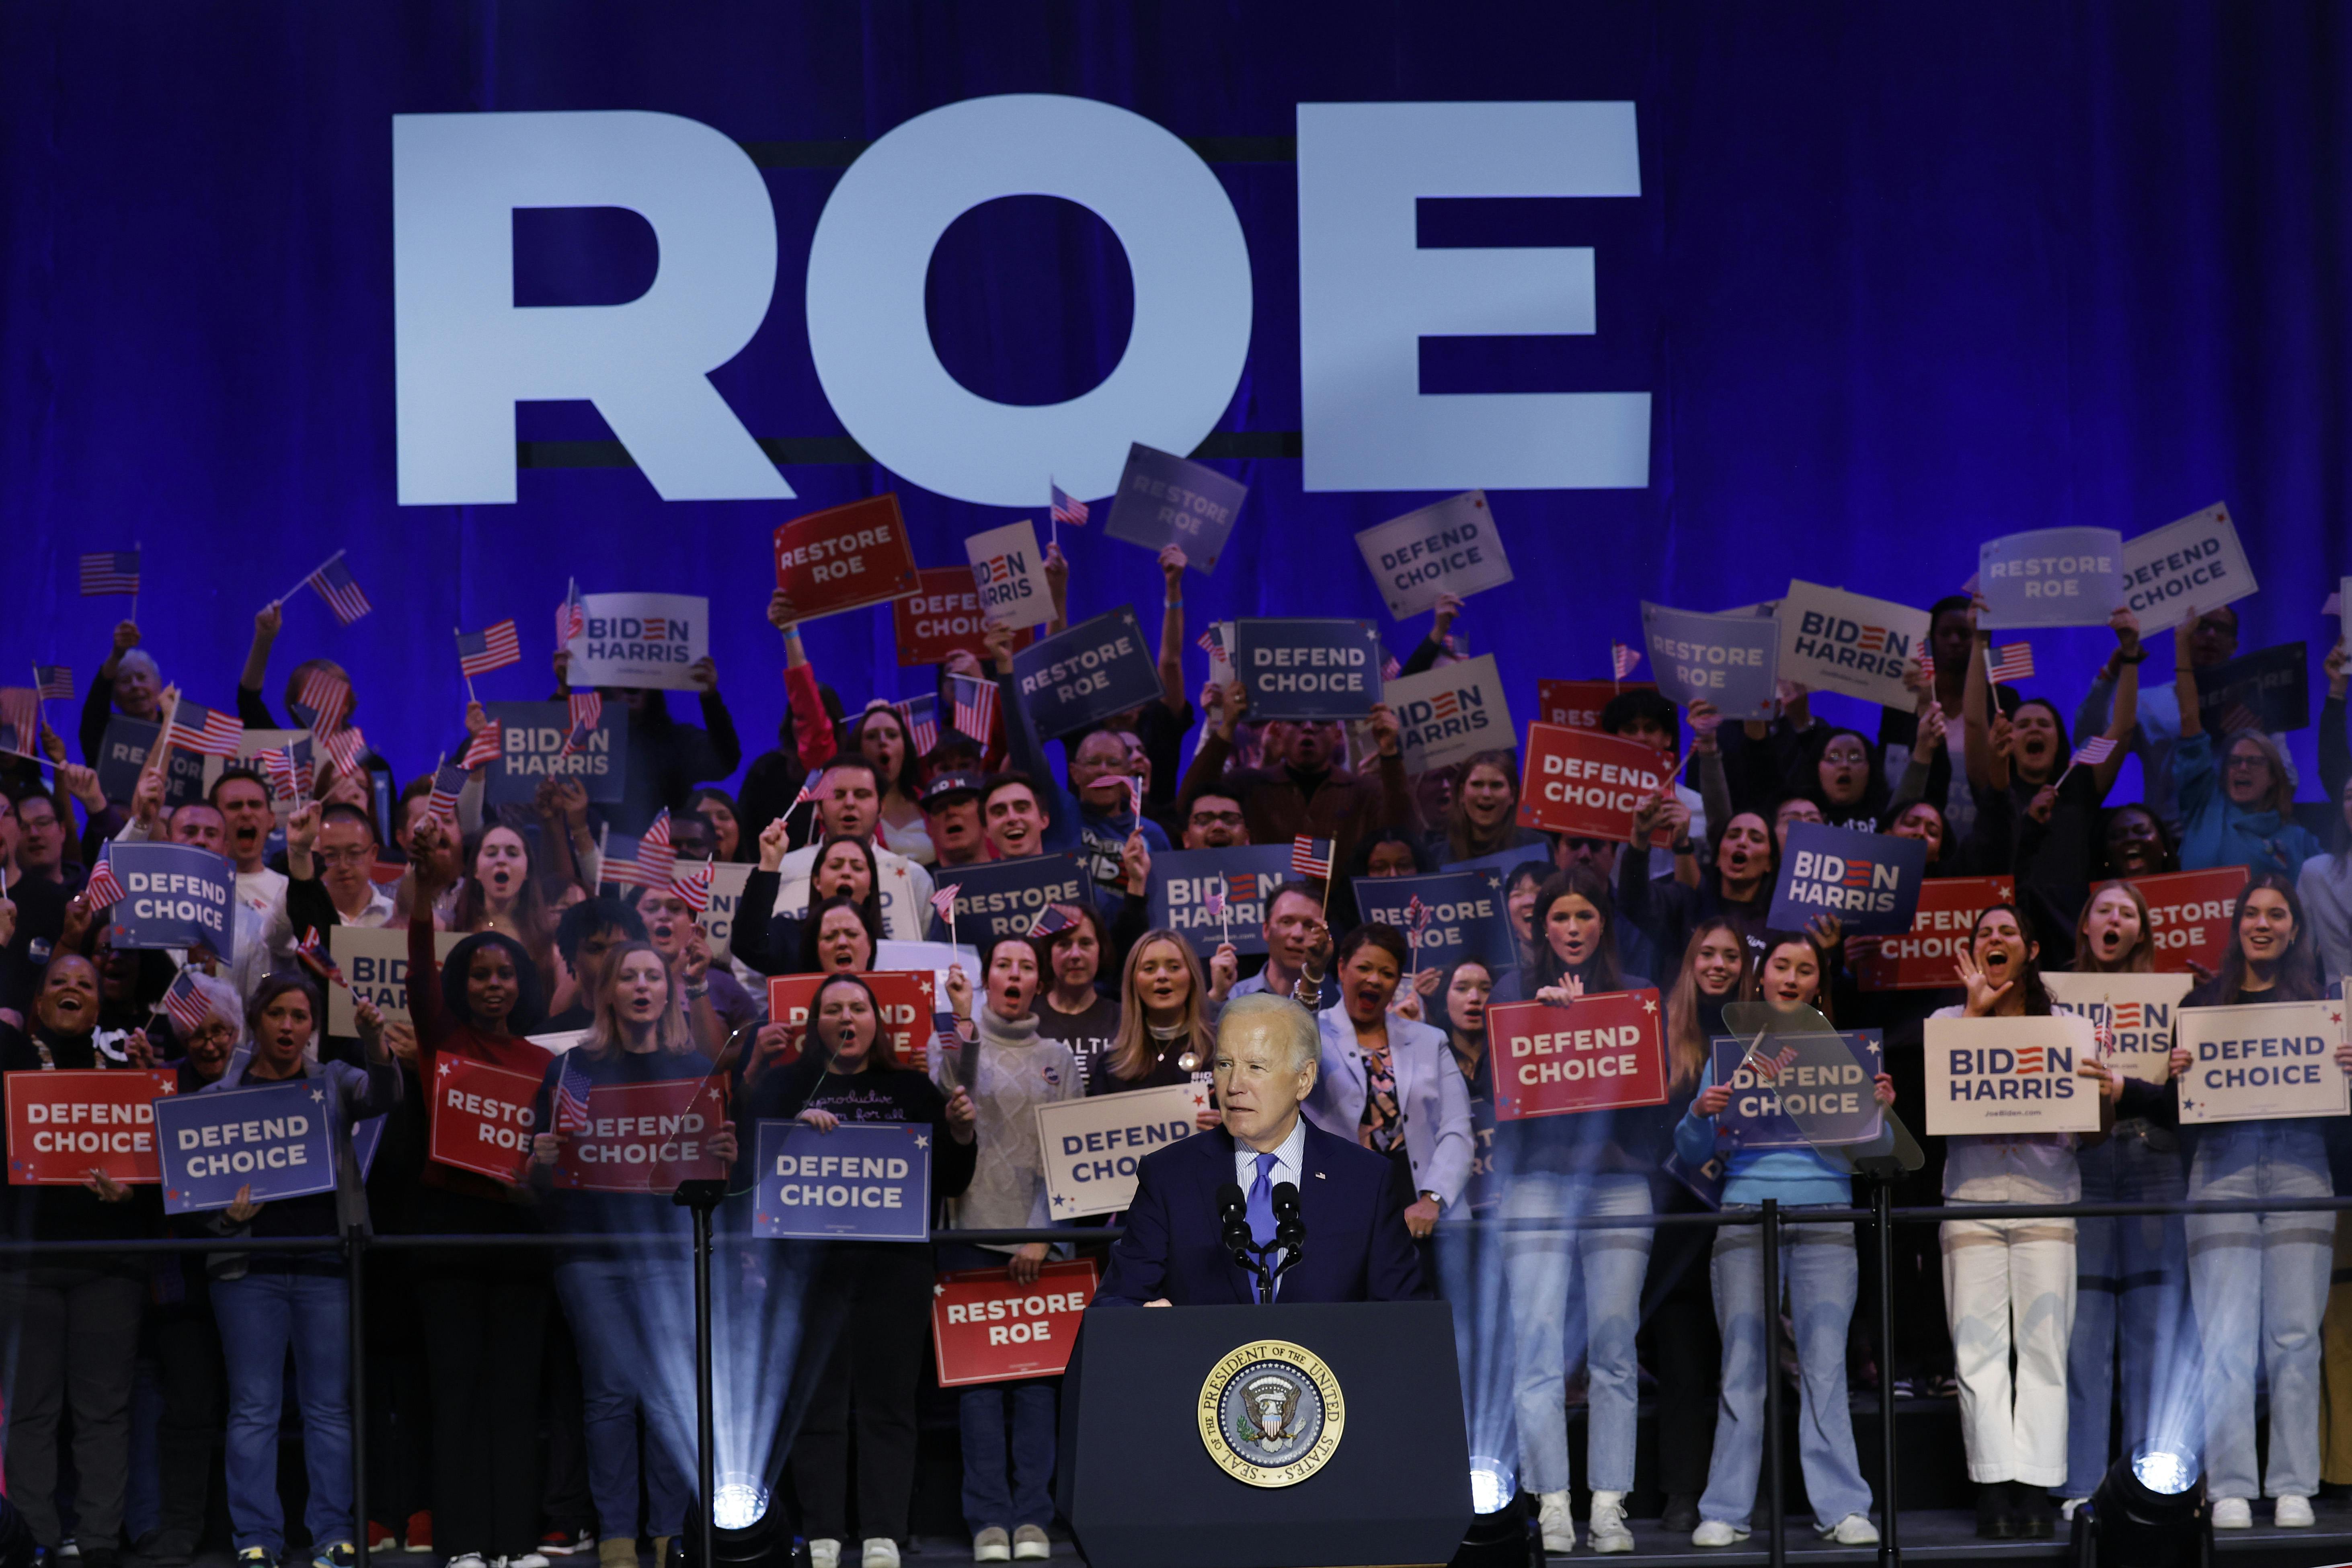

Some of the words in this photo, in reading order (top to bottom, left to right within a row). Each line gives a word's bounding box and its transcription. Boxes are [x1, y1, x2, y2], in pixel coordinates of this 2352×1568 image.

[393, 93, 1652, 507] ROE
[1133, 474, 1229, 525] RESTORE
[1159, 507, 1202, 535] ROE
[781, 525, 892, 570] RESTORE
[1381, 523, 1478, 571] DEFEND
[812, 556, 865, 584] ROE
[1395, 547, 1482, 590] CHOICE
[1991, 556, 2112, 578] RESTORE
[2025, 580, 2079, 598] ROE
[2129, 561, 2227, 611] CHOICE
[909, 592, 982, 616] DEFE
[588, 618, 689, 642] BIDEN
[915, 616, 989, 638] CHOIC
[1800, 611, 1909, 658] BIDEN
[587, 642, 690, 663] HARRIS
[1254, 647, 1366, 667] DEFEND
[1653, 634, 1765, 666] RESTORE
[1795, 637, 1903, 679] HARRIS
[1021, 637, 1134, 696] RESTORE
[1677, 664, 1726, 689] ROE
[1057, 670, 1110, 704] ROE
[1258, 673, 1364, 692] CHOICE
[1395, 685, 1482, 727] IDEN
[506, 755, 609, 776] HARRIS
[1544, 755, 1659, 790] DEFEND
[1545, 781, 1643, 813] CHOIC
[1794, 850, 1900, 891] BIDEN
[129, 872, 226, 905] DEFEND
[954, 879, 1080, 917] RESTORE
[1789, 879, 1896, 913] HARRIS
[134, 898, 223, 932] CHOICE
[1168, 899, 1265, 930] HARRI
[2151, 898, 2237, 927] STORE
[1881, 937, 1970, 959] CHOIC
[1510, 1026, 1641, 1058] DEFEND
[2198, 1036, 2325, 1061] DEFEND
[1518, 1054, 1638, 1086] CHOICE
[1950, 1047, 2073, 1075] BIDEN
[2204, 1064, 2322, 1089] CHOICE
[1950, 1078, 2075, 1101] HARRIS
[27, 1103, 154, 1124] DEFEND
[447, 1088, 535, 1127] RESTO
[1738, 1093, 1860, 1118] CHOICE
[33, 1131, 152, 1153] CHOICE
[178, 1115, 309, 1151] DEFEND
[1062, 1120, 1190, 1156] DEFEND
[187, 1144, 308, 1178] CHOICE
[578, 1141, 700, 1163] CHOICE
[776, 1155, 909, 1180] DEFEND
[780, 1184, 903, 1208] CHOICE
[947, 1291, 1086, 1325] RESTORE
[989, 1320, 1051, 1346] ROE
[1272, 1347, 1285, 1356] OF
[1288, 1350, 1306, 1364] THE
[1204, 1346, 1267, 1410] PRESIDENT
[1309, 1362, 1340, 1422] UNITED
[1205, 1416, 1215, 1436] THE
[1211, 1437, 1223, 1450] OF
[1285, 1435, 1334, 1480] STATES
[1221, 1449, 1259, 1480] SEAL
